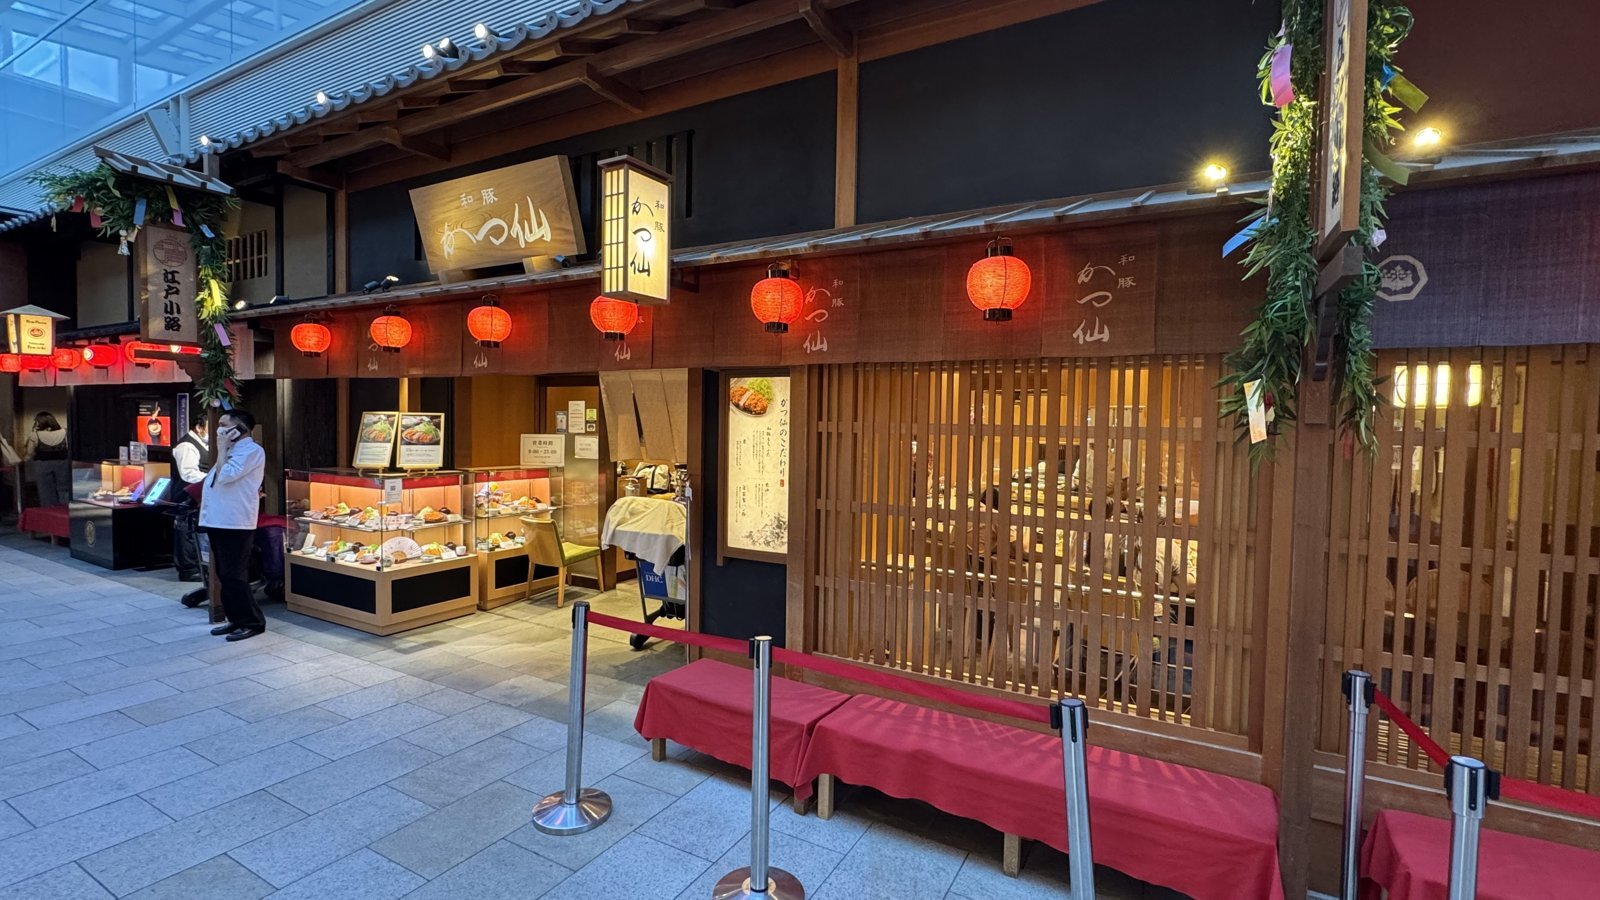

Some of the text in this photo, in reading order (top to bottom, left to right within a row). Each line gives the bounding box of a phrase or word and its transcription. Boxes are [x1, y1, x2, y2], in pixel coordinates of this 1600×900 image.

[440, 195, 552, 259] かつ仙
[460, 187, 498, 208] 和豚
[654, 200, 665, 233] 和豚
[630, 196, 654, 277] かつ仙
[163, 268, 182, 332] 江戸小路
[832, 279, 845, 308] 和豚
[1117, 254, 1137, 288] 和豚
[803, 286, 831, 354] かつ仙
[1072, 262, 1116, 345] かつ仙
[779, 398, 788, 478] かつ仙のこだわり
[645, 574, 664, 583] DHC
